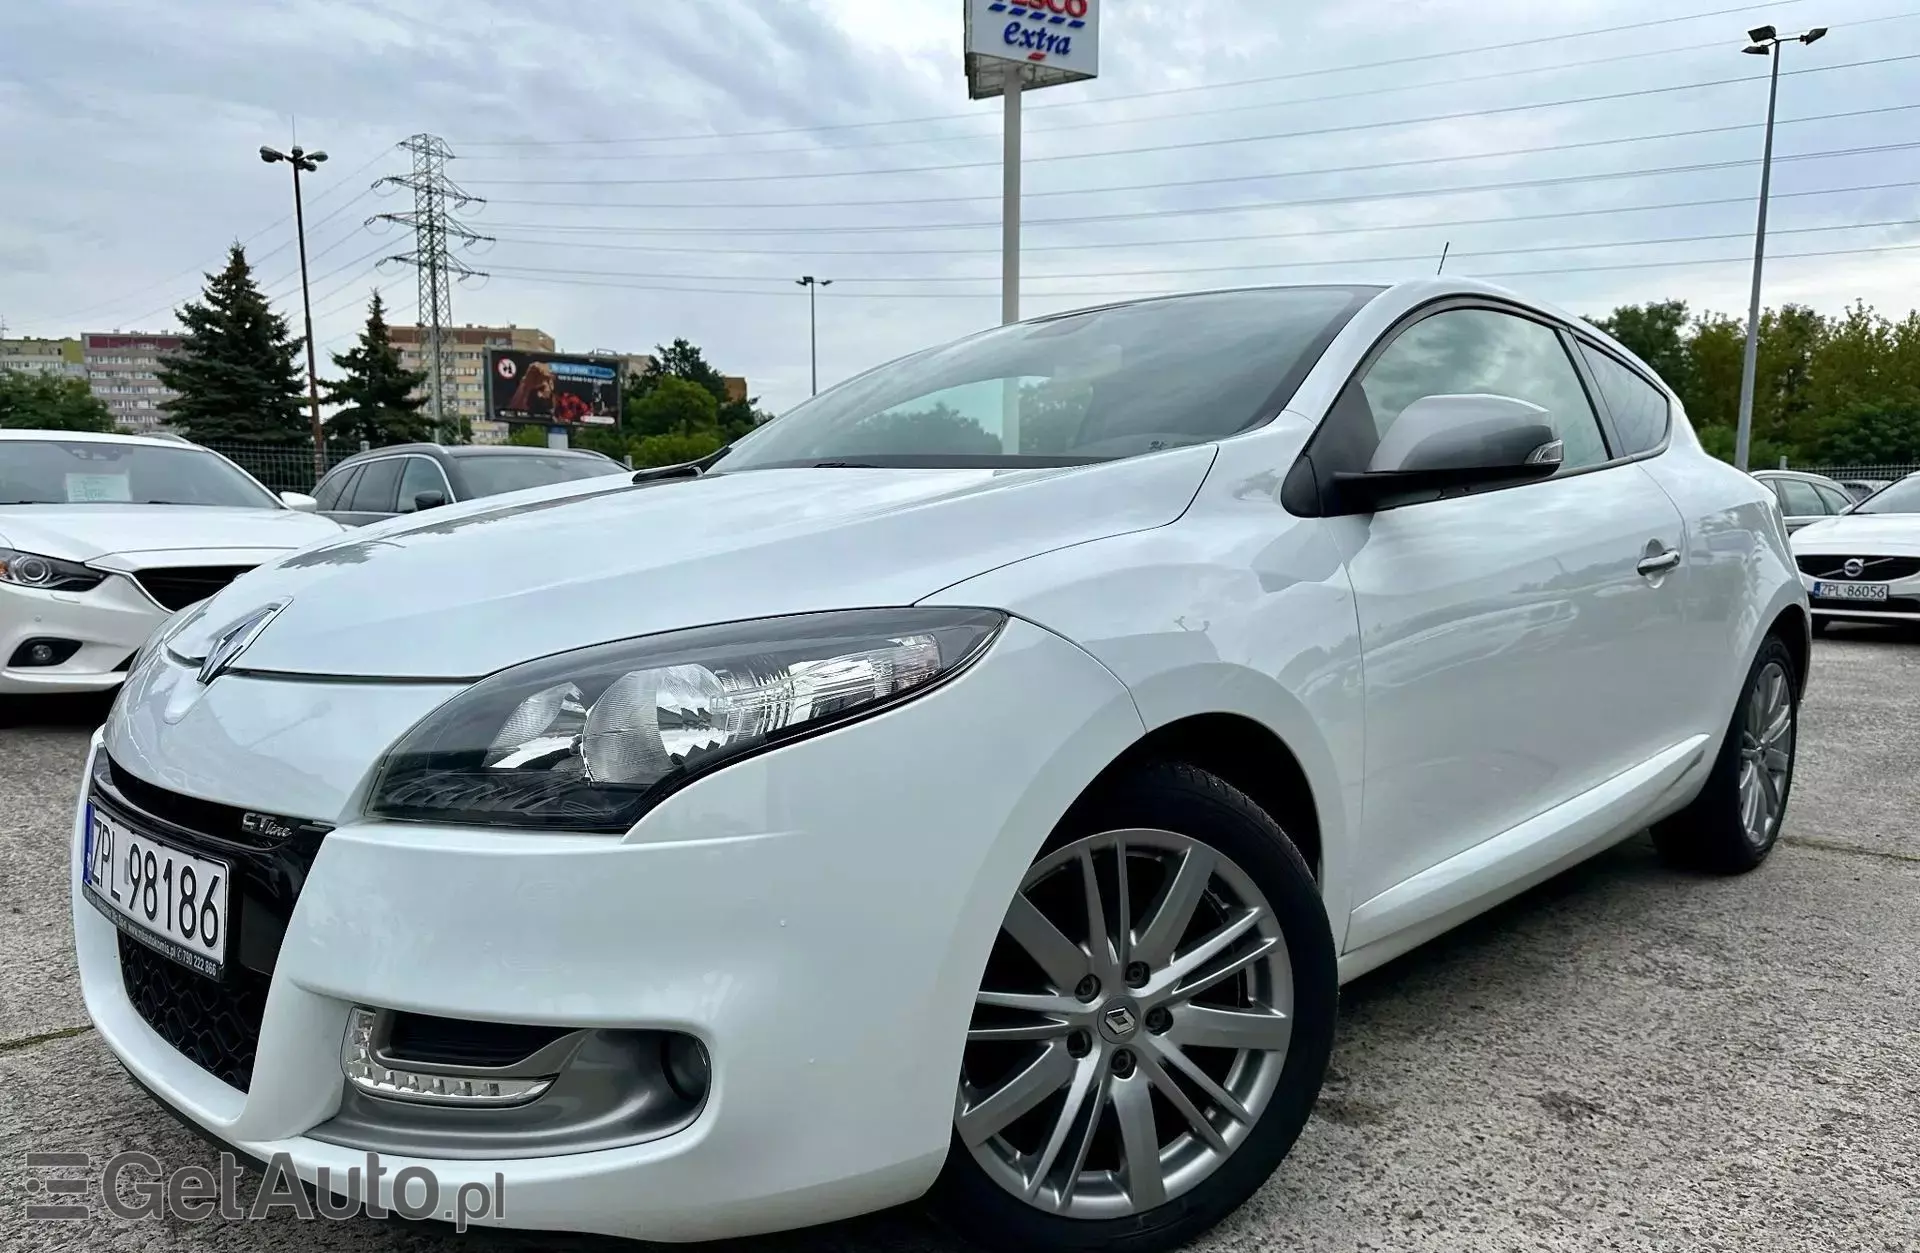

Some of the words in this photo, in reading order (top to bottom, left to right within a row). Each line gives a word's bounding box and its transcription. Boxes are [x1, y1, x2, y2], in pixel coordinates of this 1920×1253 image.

[1004, 22, 1071, 55] extra
[1820, 585, 1843, 597] ZPL
[1846, 586, 1885, 598] 86056
[93, 818, 121, 902] ZPL
[129, 843, 220, 947] 98186
[193, 954, 204, 971] 222
